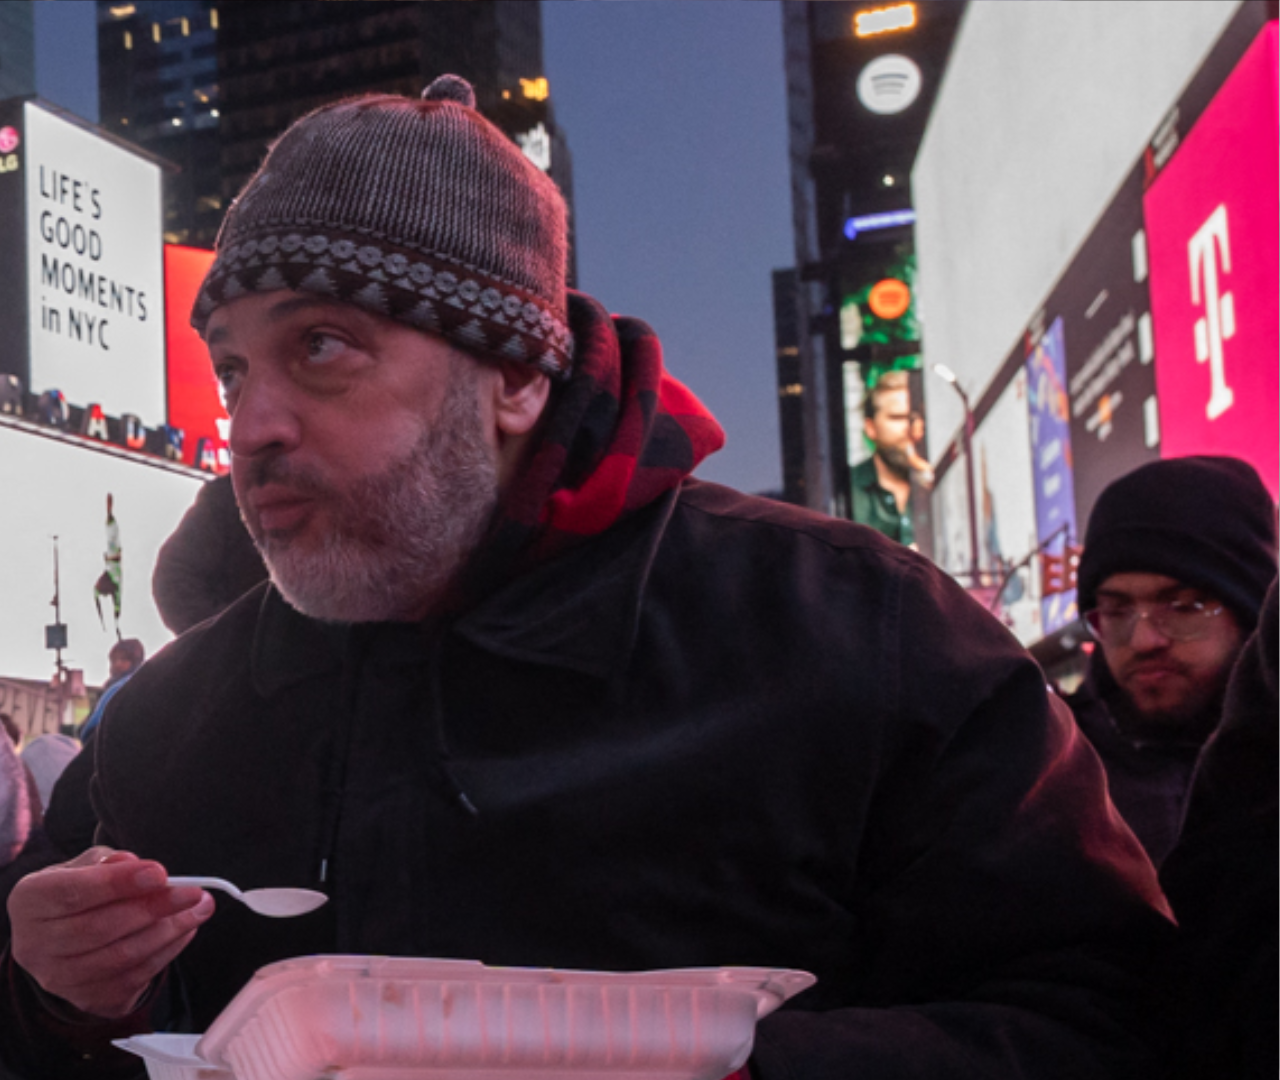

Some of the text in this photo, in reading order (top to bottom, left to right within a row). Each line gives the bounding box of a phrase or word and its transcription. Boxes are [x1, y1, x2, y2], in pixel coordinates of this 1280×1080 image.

[40, 165, 102, 220] LIFE'S
[41, 210, 102, 261] GOOD
[41, 253, 147, 322] MOMENTS
[1187, 202, 1237, 421] T
[41, 297, 109, 351] in NYC
